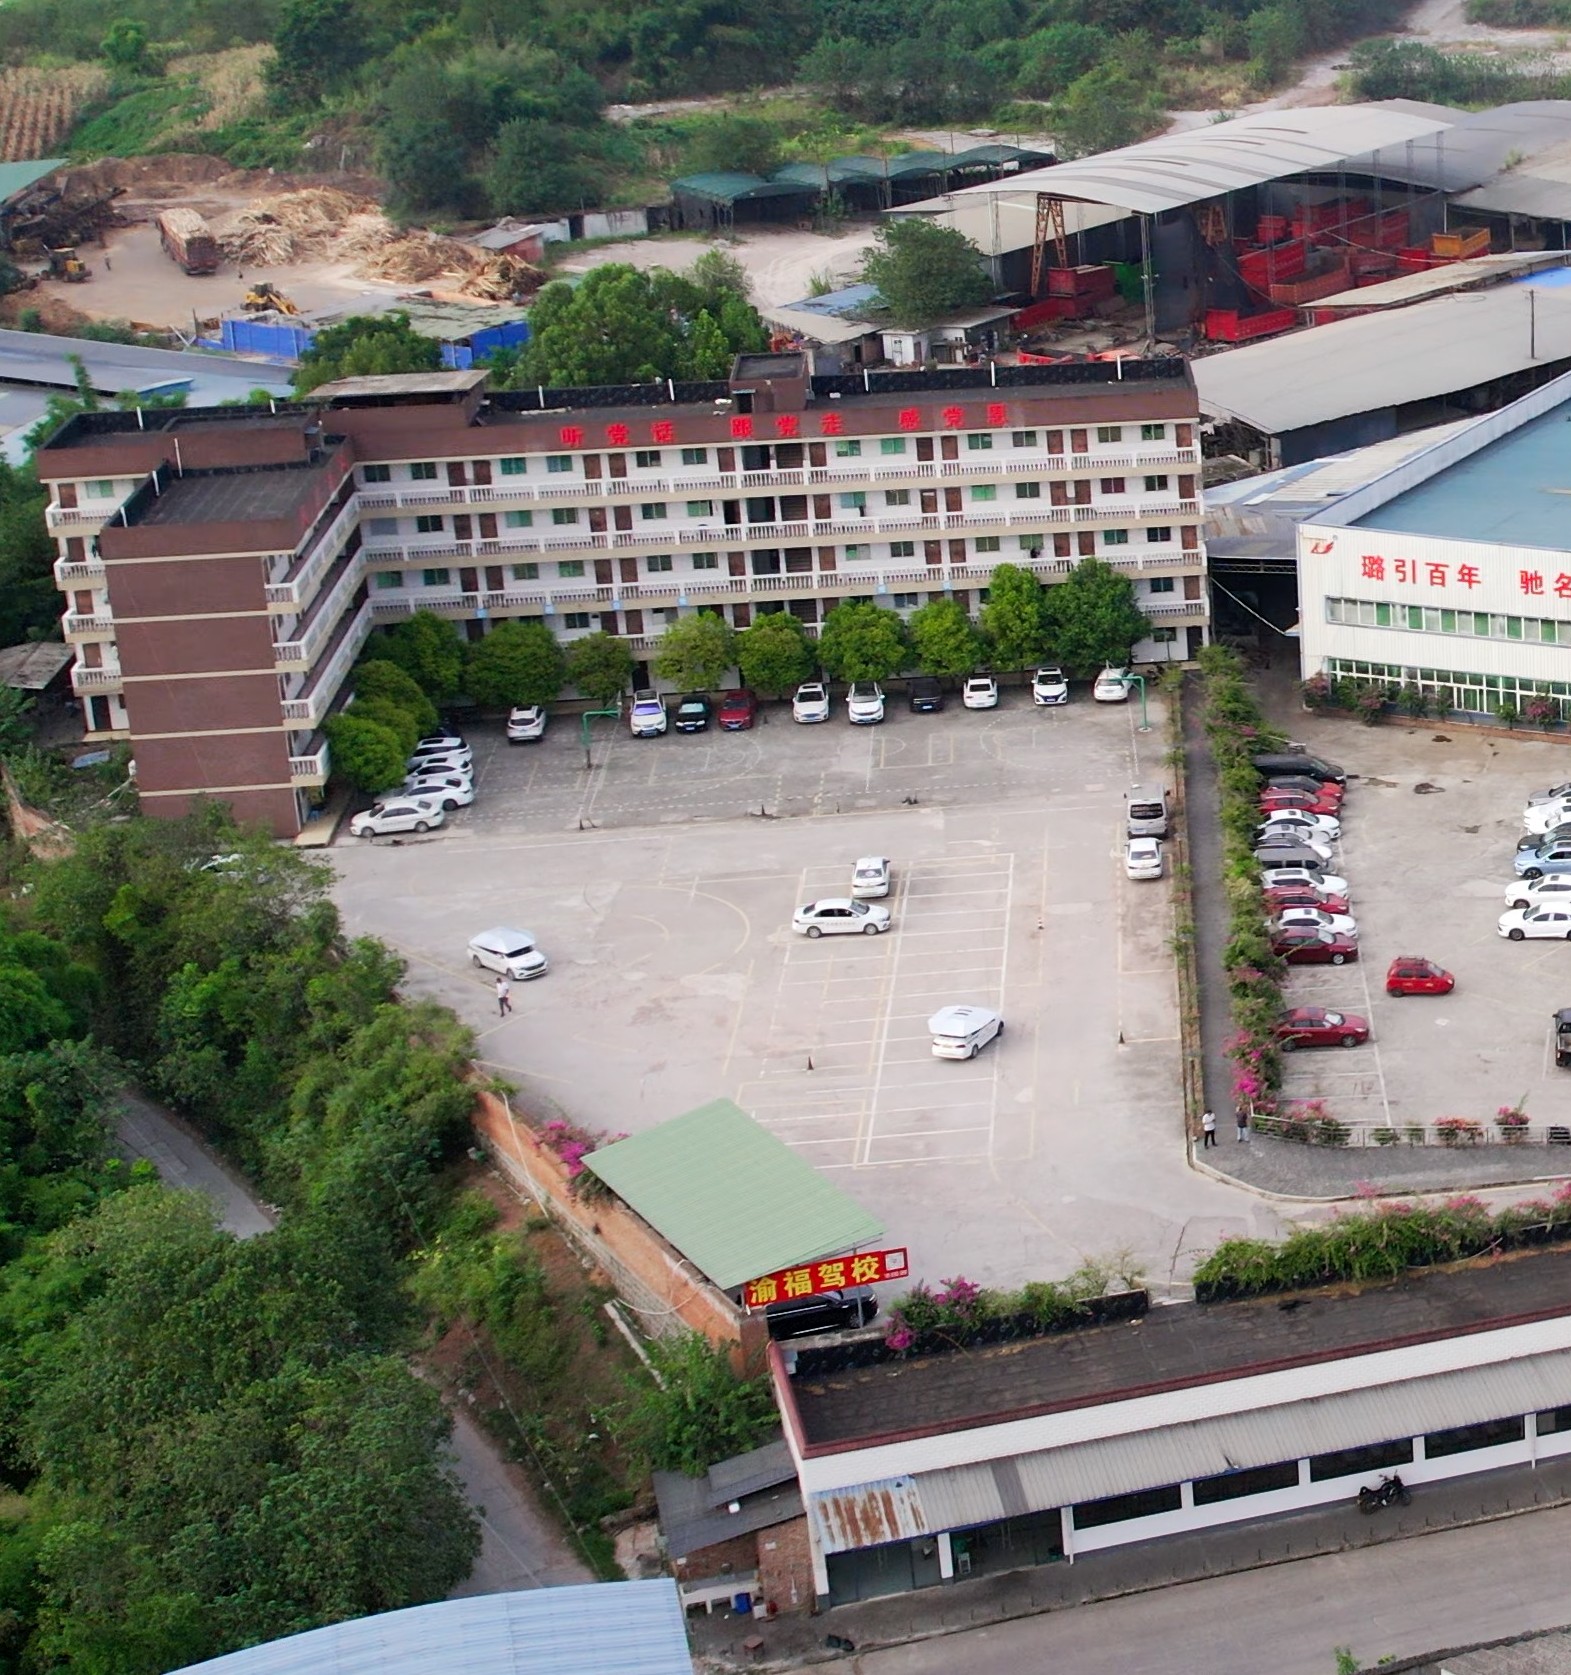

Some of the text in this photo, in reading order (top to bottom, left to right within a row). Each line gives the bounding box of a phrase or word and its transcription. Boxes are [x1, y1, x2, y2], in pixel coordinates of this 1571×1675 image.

[559, 402, 1008, 447] 听党话 跟党走 感党恩
[1361, 555, 1482, 589] 璐引百年
[749, 1255, 881, 1304] 渝福驾校
